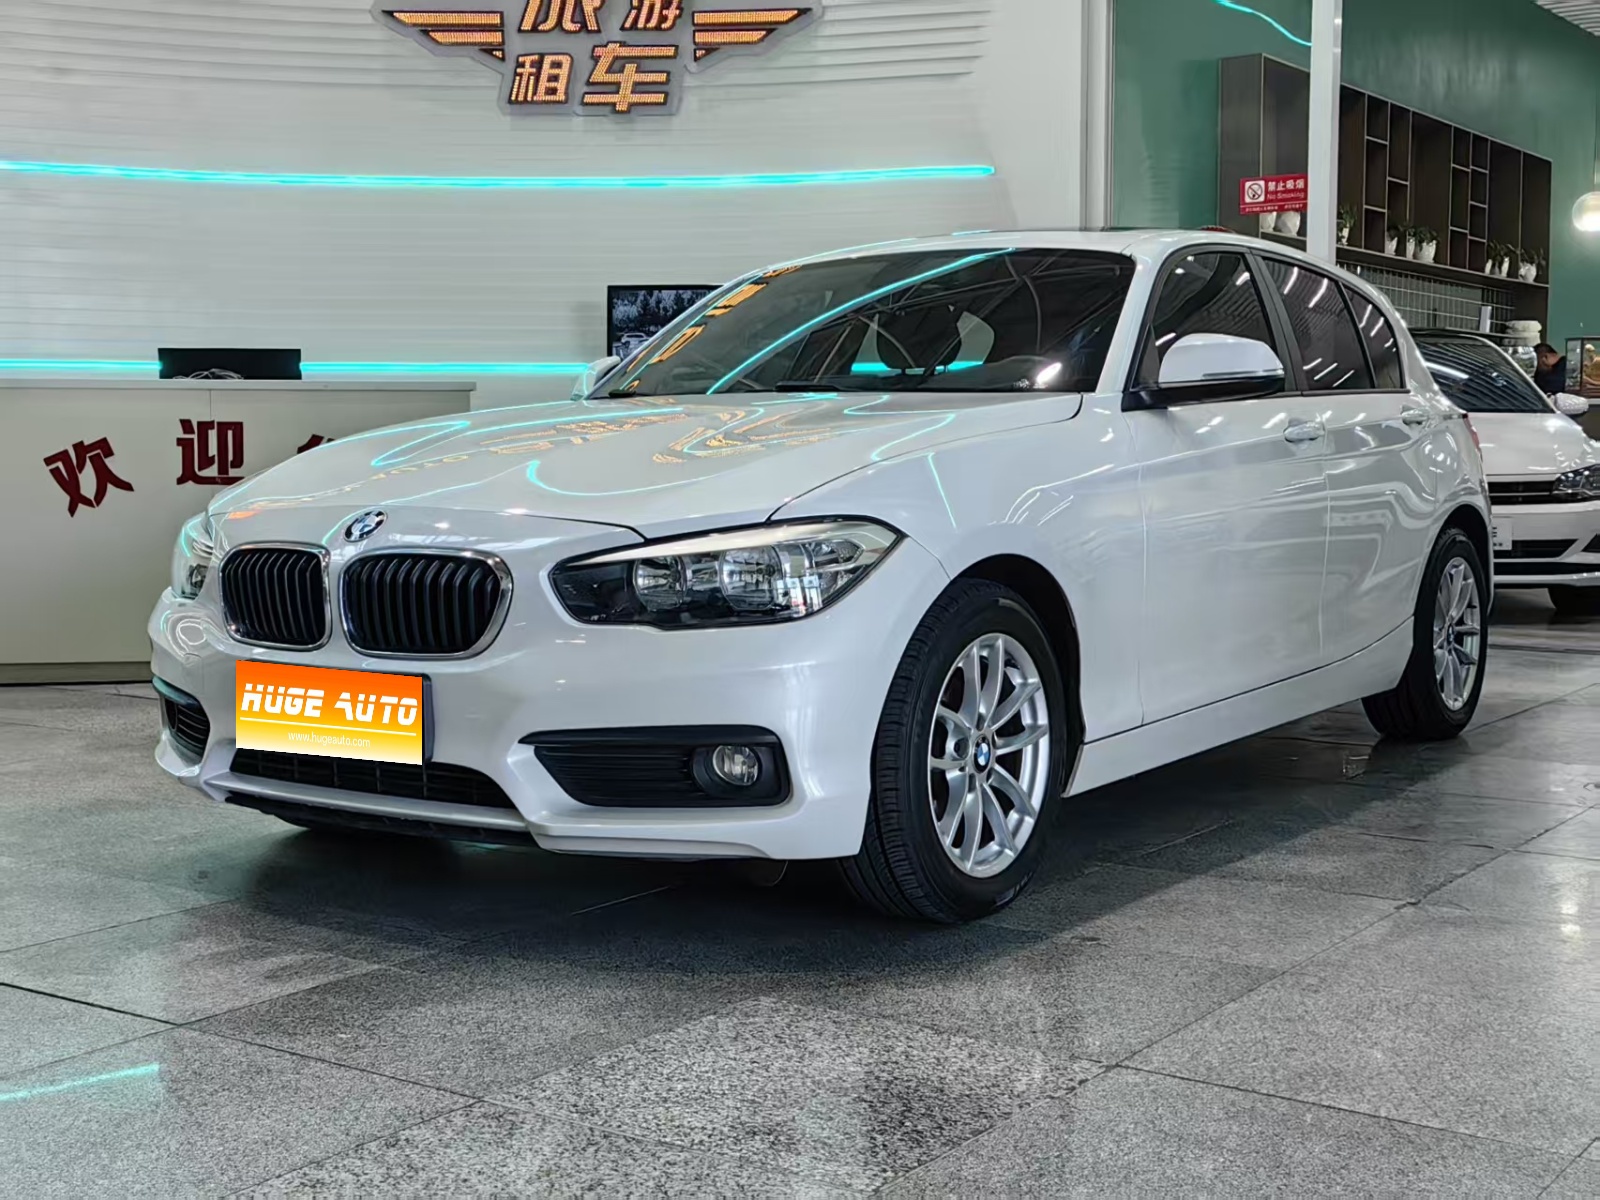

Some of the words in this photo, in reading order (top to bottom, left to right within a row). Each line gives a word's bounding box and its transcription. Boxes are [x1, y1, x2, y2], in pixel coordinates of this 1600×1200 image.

[509, 42, 678, 112] 租车
[1268, 179, 1305, 192] 禁止吸烟
[43, 418, 336, 518] 欢迎
